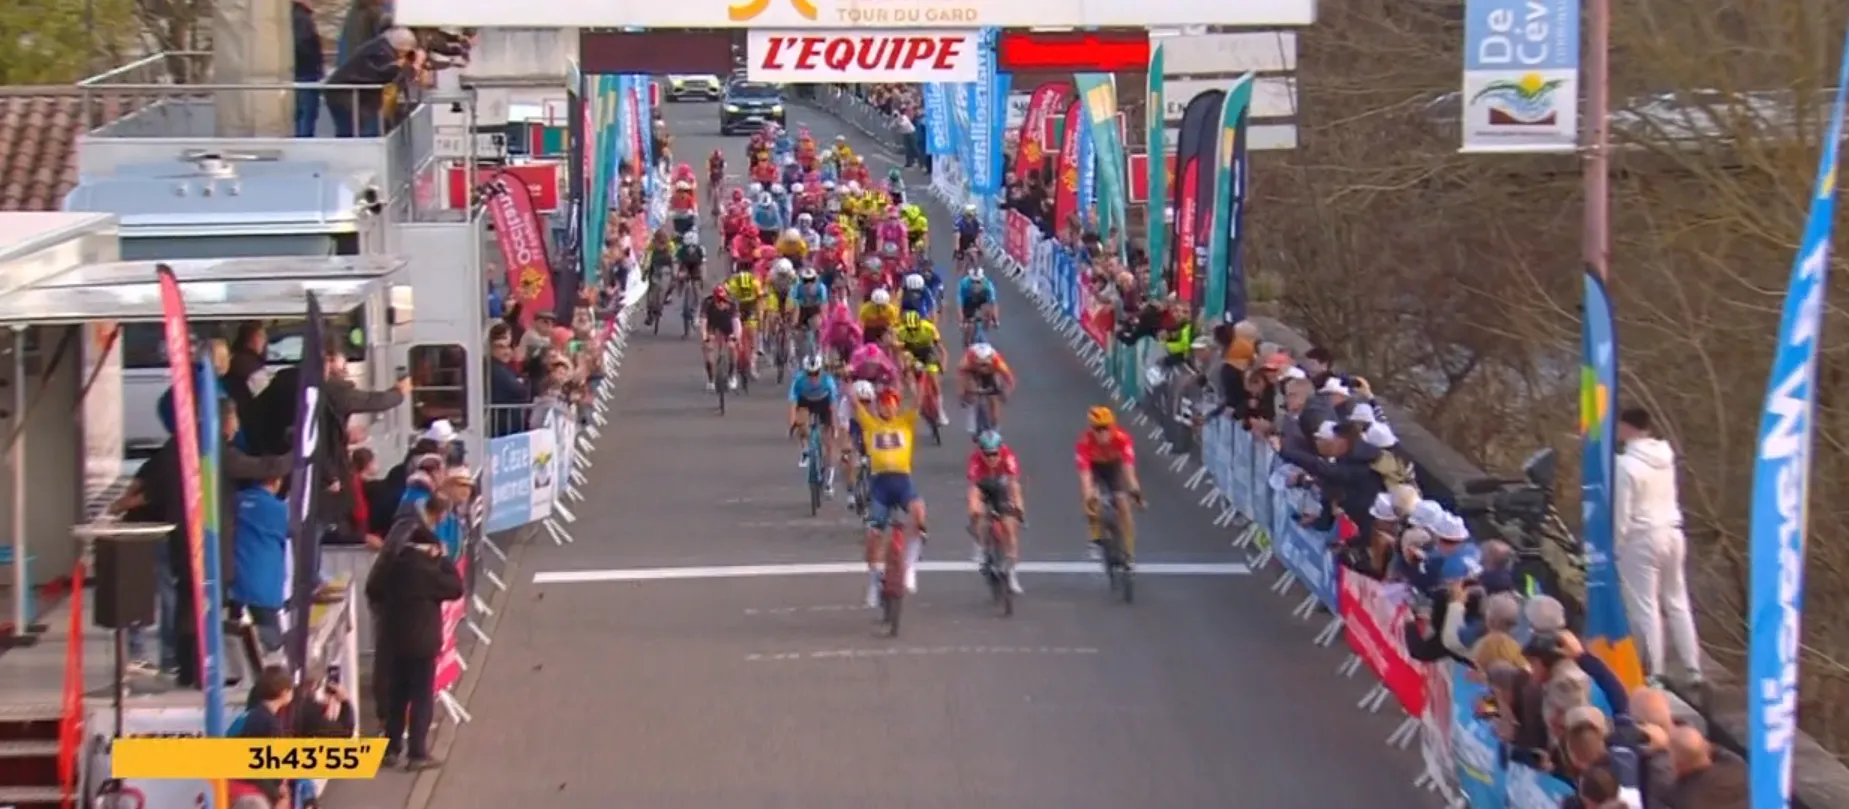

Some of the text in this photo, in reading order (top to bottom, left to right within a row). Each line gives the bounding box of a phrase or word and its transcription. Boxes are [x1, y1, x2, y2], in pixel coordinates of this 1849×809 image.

[836, 8, 978, 22] TOUR DU GARD
[1478, 8, 1514, 64] De
[762, 37, 965, 71] L'EQUIPE
